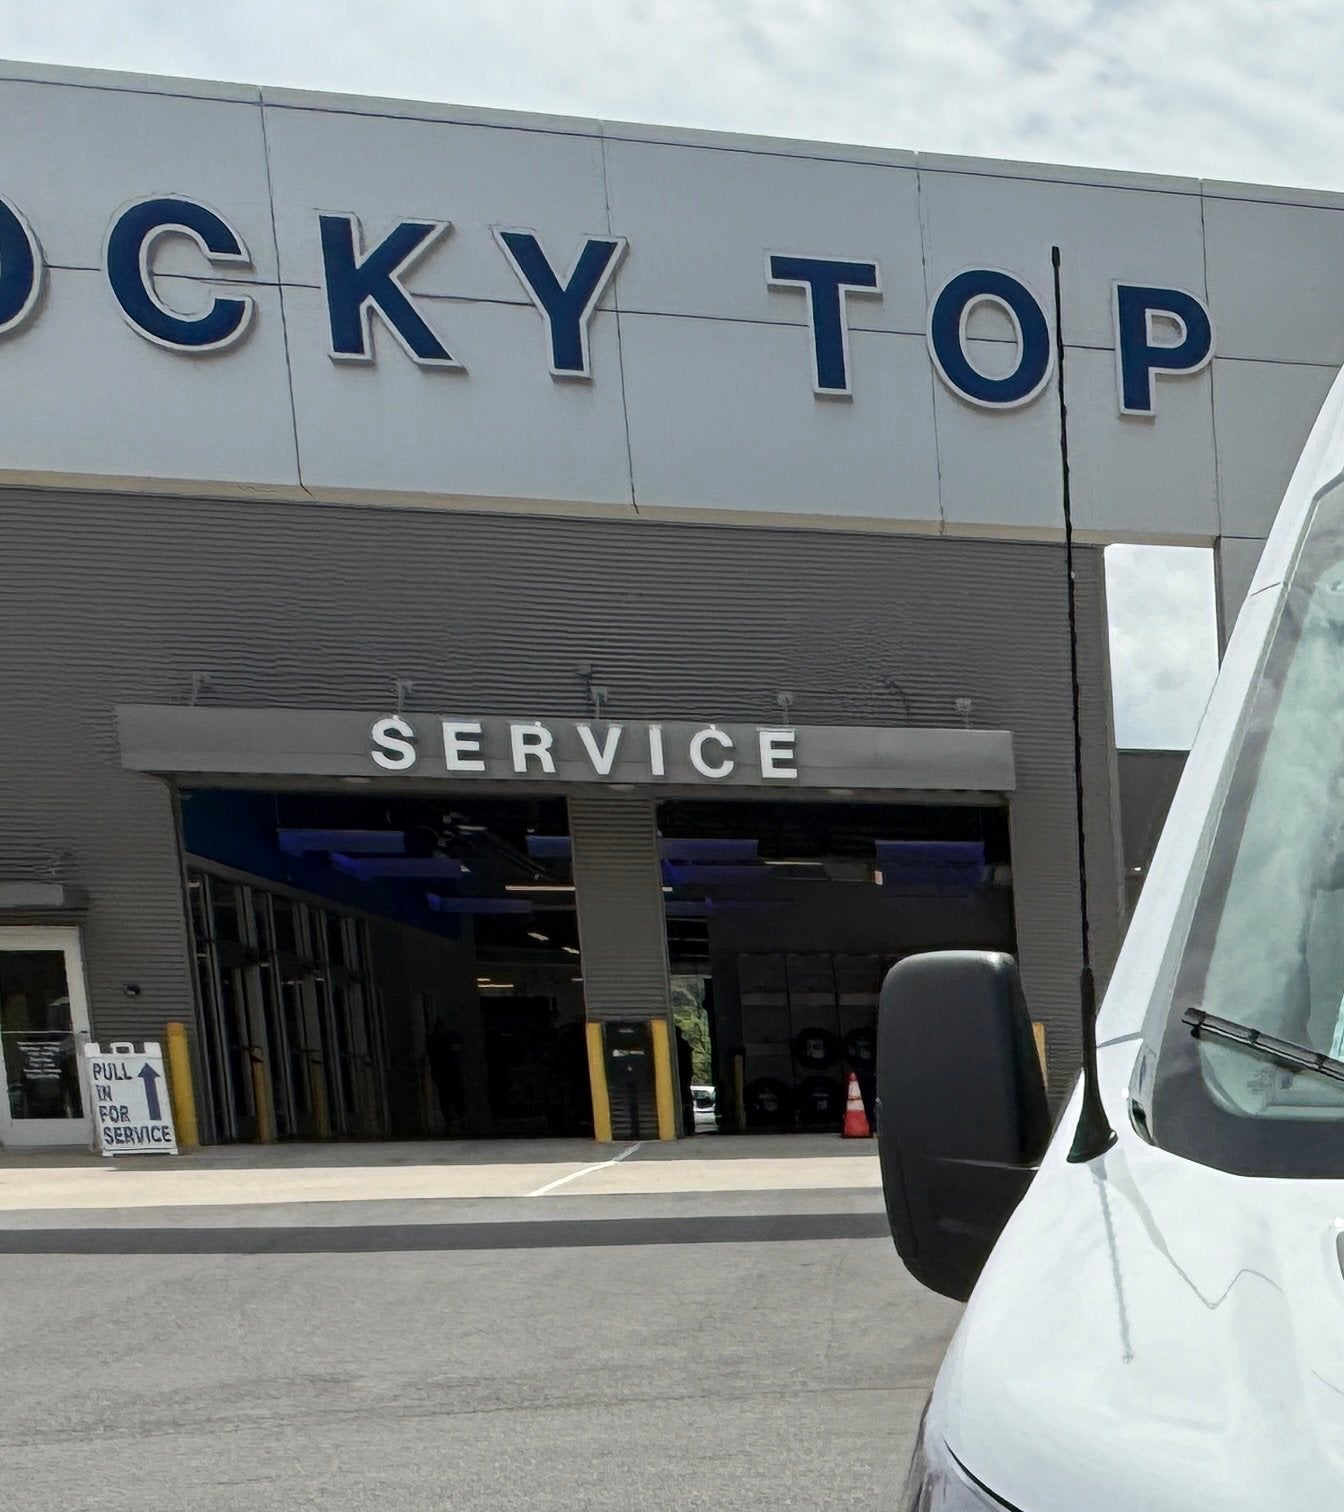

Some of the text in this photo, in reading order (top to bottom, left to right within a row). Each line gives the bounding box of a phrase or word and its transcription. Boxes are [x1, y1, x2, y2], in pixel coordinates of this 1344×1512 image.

[766, 251, 1215, 417] TOP
[370, 716, 798, 780] SERVICE
[92, 1061, 133, 1081] PULL
[96, 1084, 113, 1102] IN
[99, 1105, 131, 1124] FOR
[103, 1125, 173, 1146] SERVICE
